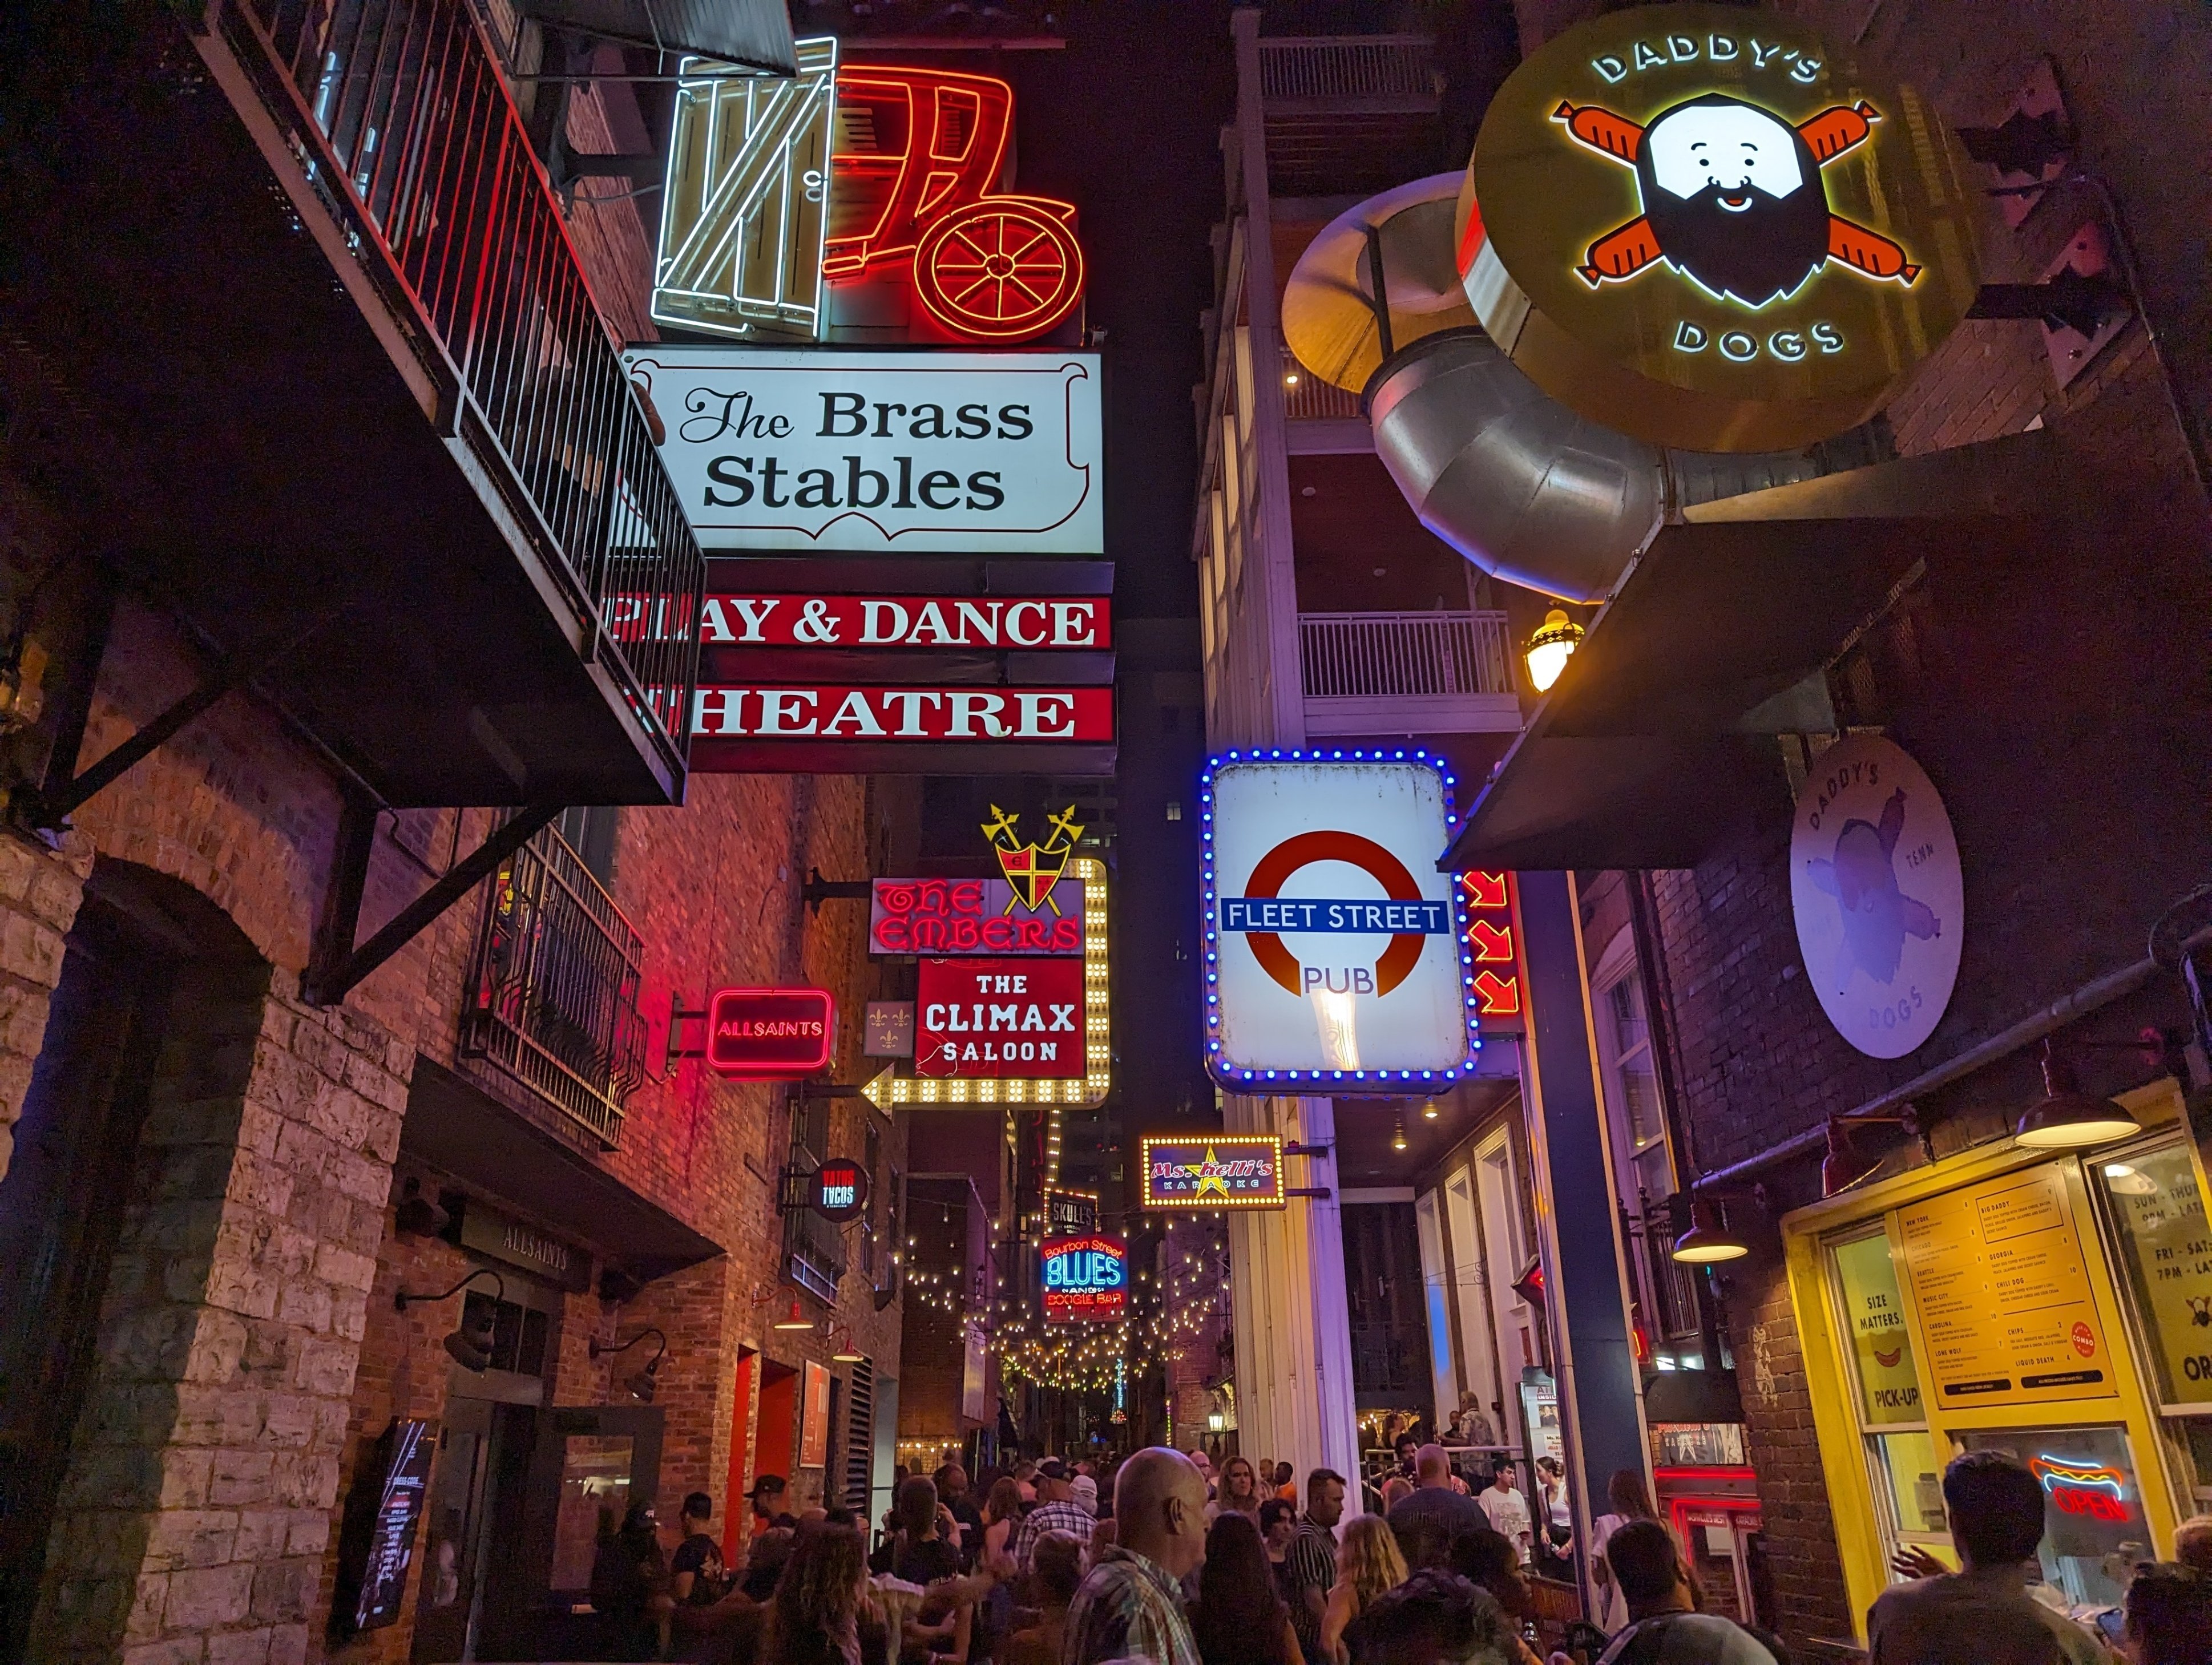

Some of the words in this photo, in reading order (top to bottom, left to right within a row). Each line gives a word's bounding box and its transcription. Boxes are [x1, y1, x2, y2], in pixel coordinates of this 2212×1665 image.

[1592, 33, 1821, 83] DADDY'S
[1673, 321, 1844, 362] DOGS
[680, 387, 794, 443] The
[816, 391, 1034, 439] Brass
[703, 455, 1006, 511] Stables
[793, 599, 841, 644] &
[858, 600, 1095, 646] DANCE
[1809, 761, 1878, 831] DADDY'S
[1906, 843, 1934, 868] TENN
[1229, 904, 1317, 927] FLEET
[1329, 905, 1440, 930] STREET
[875, 915, 1080, 951] EMBERS
[976, 975, 1027, 994] THE
[1303, 967, 1374, 995] PUB
[926, 1003, 1076, 1032] CLIMAX
[1869, 985, 1923, 1029] DOGS
[717, 1021, 823, 1036] ALLSAINTS
[943, 1042, 1057, 1061] SALOON
[1150, 1162, 1193, 1179] Ms.
[1198, 1159, 1274, 1178] Kelli's
[1164, 1179, 1260, 1190] KARAOKE
[823, 1186, 854, 1205] TACOS
[2133, 1195, 2157, 1209] SUN
[1053, 1202, 1092, 1226] SKULL'S
[1992, 1201, 2009, 1212] DADDY
[503, 1226, 567, 1270] ALLSAINTS
[1044, 1240, 1089, 1260] Bourbon
[1091, 1239, 1123, 1259] Street
[1989, 1250, 2013, 1260] GEORGIA
[2156, 1247, 2174, 1262] FRI
[1047, 1251, 1121, 1286] BLUES
[2157, 1266, 2183, 1281] 7PM
[1096, 1293, 1122, 1304] BAR
[1867, 1294, 1887, 1310] SIZE
[1860, 1312, 1904, 1331] MATTERS.
[2008, 1327, 2024, 1336] CHIPS
[2073, 1335, 2094, 1346] COMBO
[2016, 1358, 2035, 1367] LIQUID
[1874, 1387, 1919, 1408] PICK-UP
[2053, 1486, 2128, 1522] OPEN
